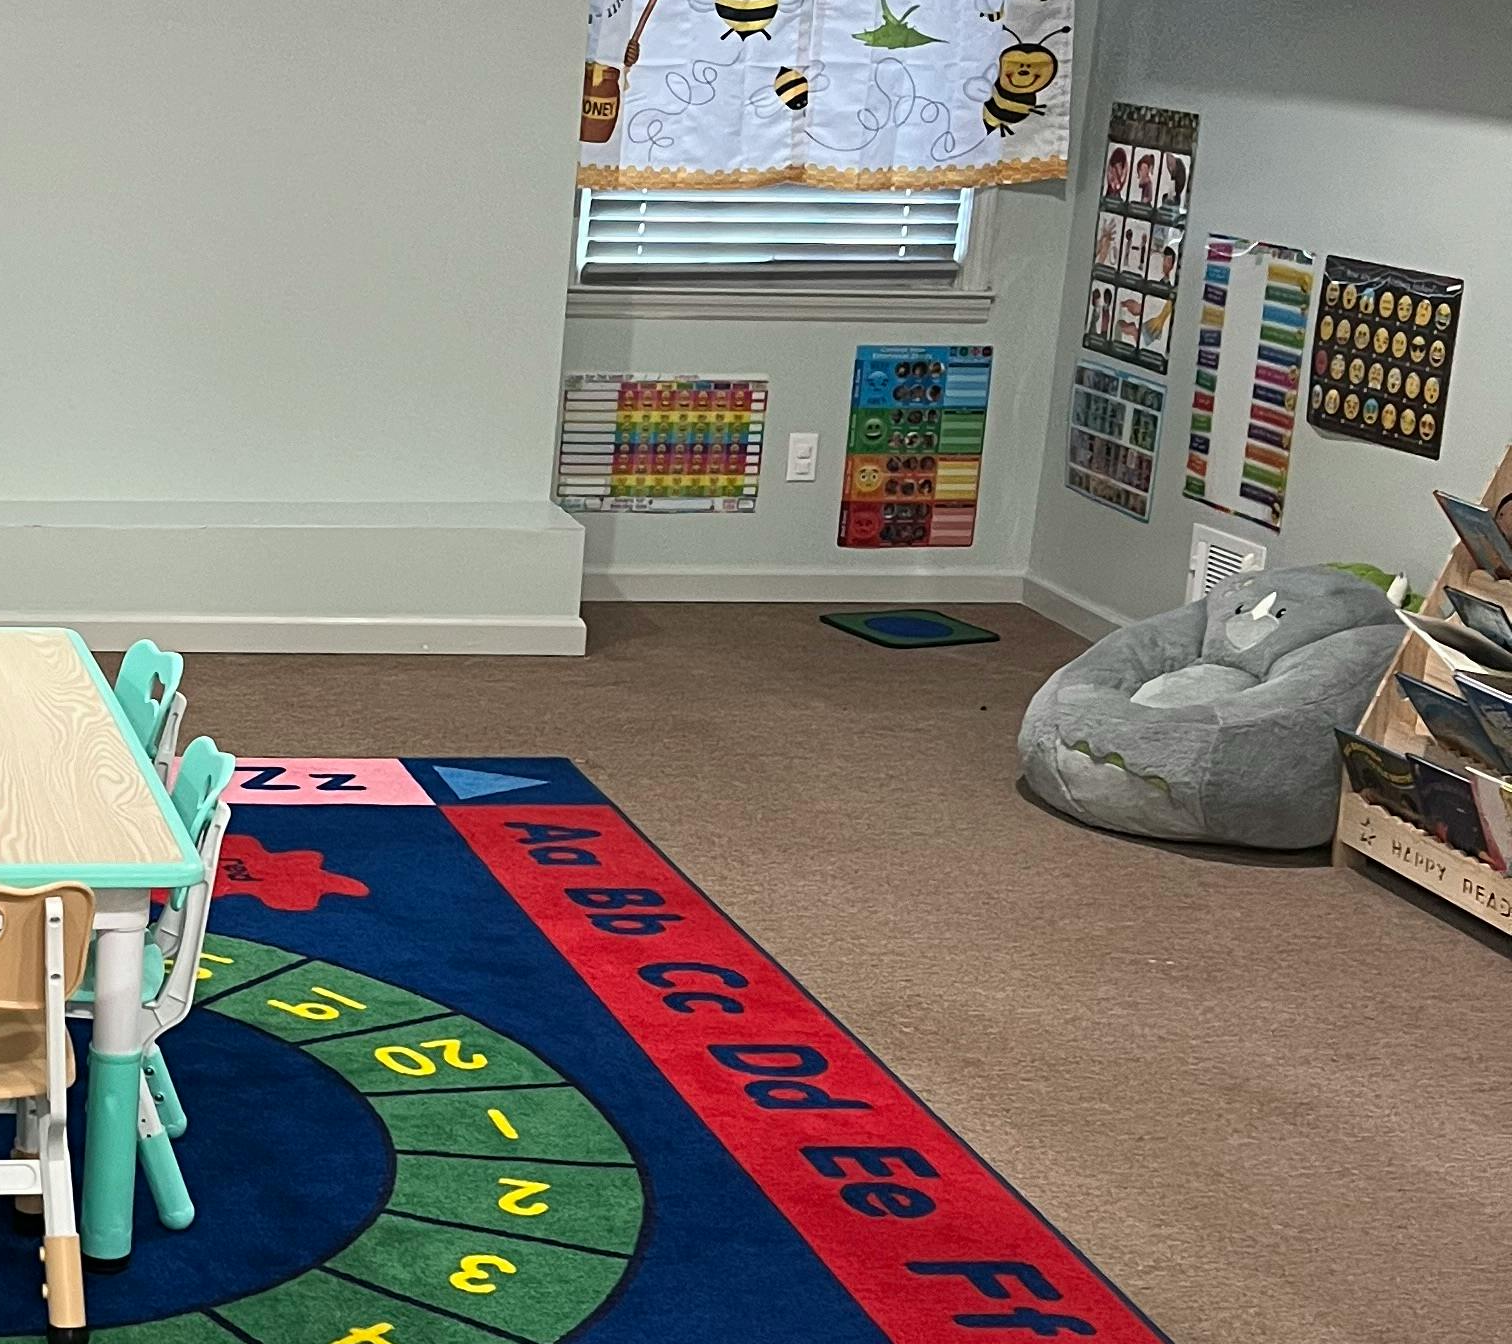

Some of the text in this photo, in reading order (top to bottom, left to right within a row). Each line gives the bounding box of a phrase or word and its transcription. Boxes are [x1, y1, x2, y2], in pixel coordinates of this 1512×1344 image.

[234, 766, 367, 791] Zz
[1391, 838, 1448, 882] HAPPY
[267, 986, 368, 1022] 19
[374, 1038, 488, 1072] 20
[502, 821, 602, 867] Aa
[563, 887, 687, 937] Bb
[637, 961, 749, 1014] Cc
[705, 1043, 874, 1111] Dd
[798, 1145, 942, 1220] Ee
[904, 1260, 1098, 1337] Ff
[487, 1108, 519, 1141] 1
[497, 1177, 551, 1217] 2
[448, 1253, 518, 1295] 3
